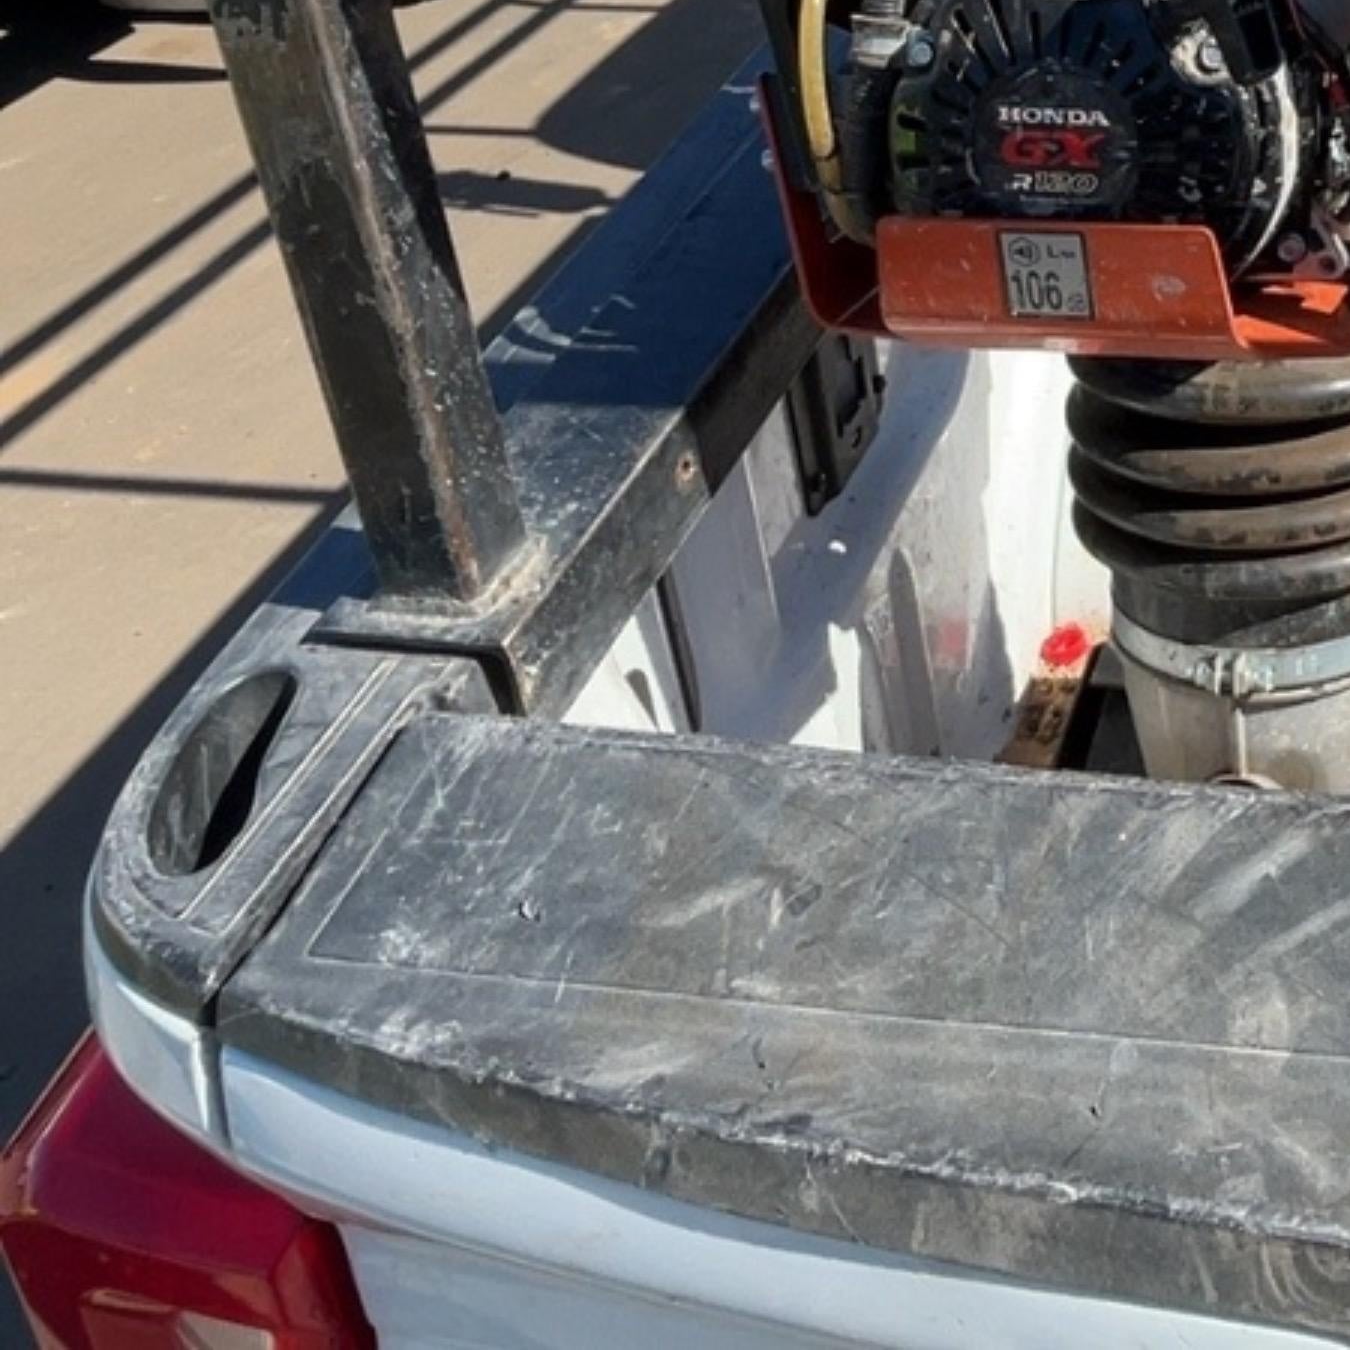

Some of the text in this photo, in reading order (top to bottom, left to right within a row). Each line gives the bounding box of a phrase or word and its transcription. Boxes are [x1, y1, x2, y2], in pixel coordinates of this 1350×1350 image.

[998, 105, 1111, 127] HONDA
[1001, 130, 1105, 169] GX
[1010, 270, 1063, 310] 106
